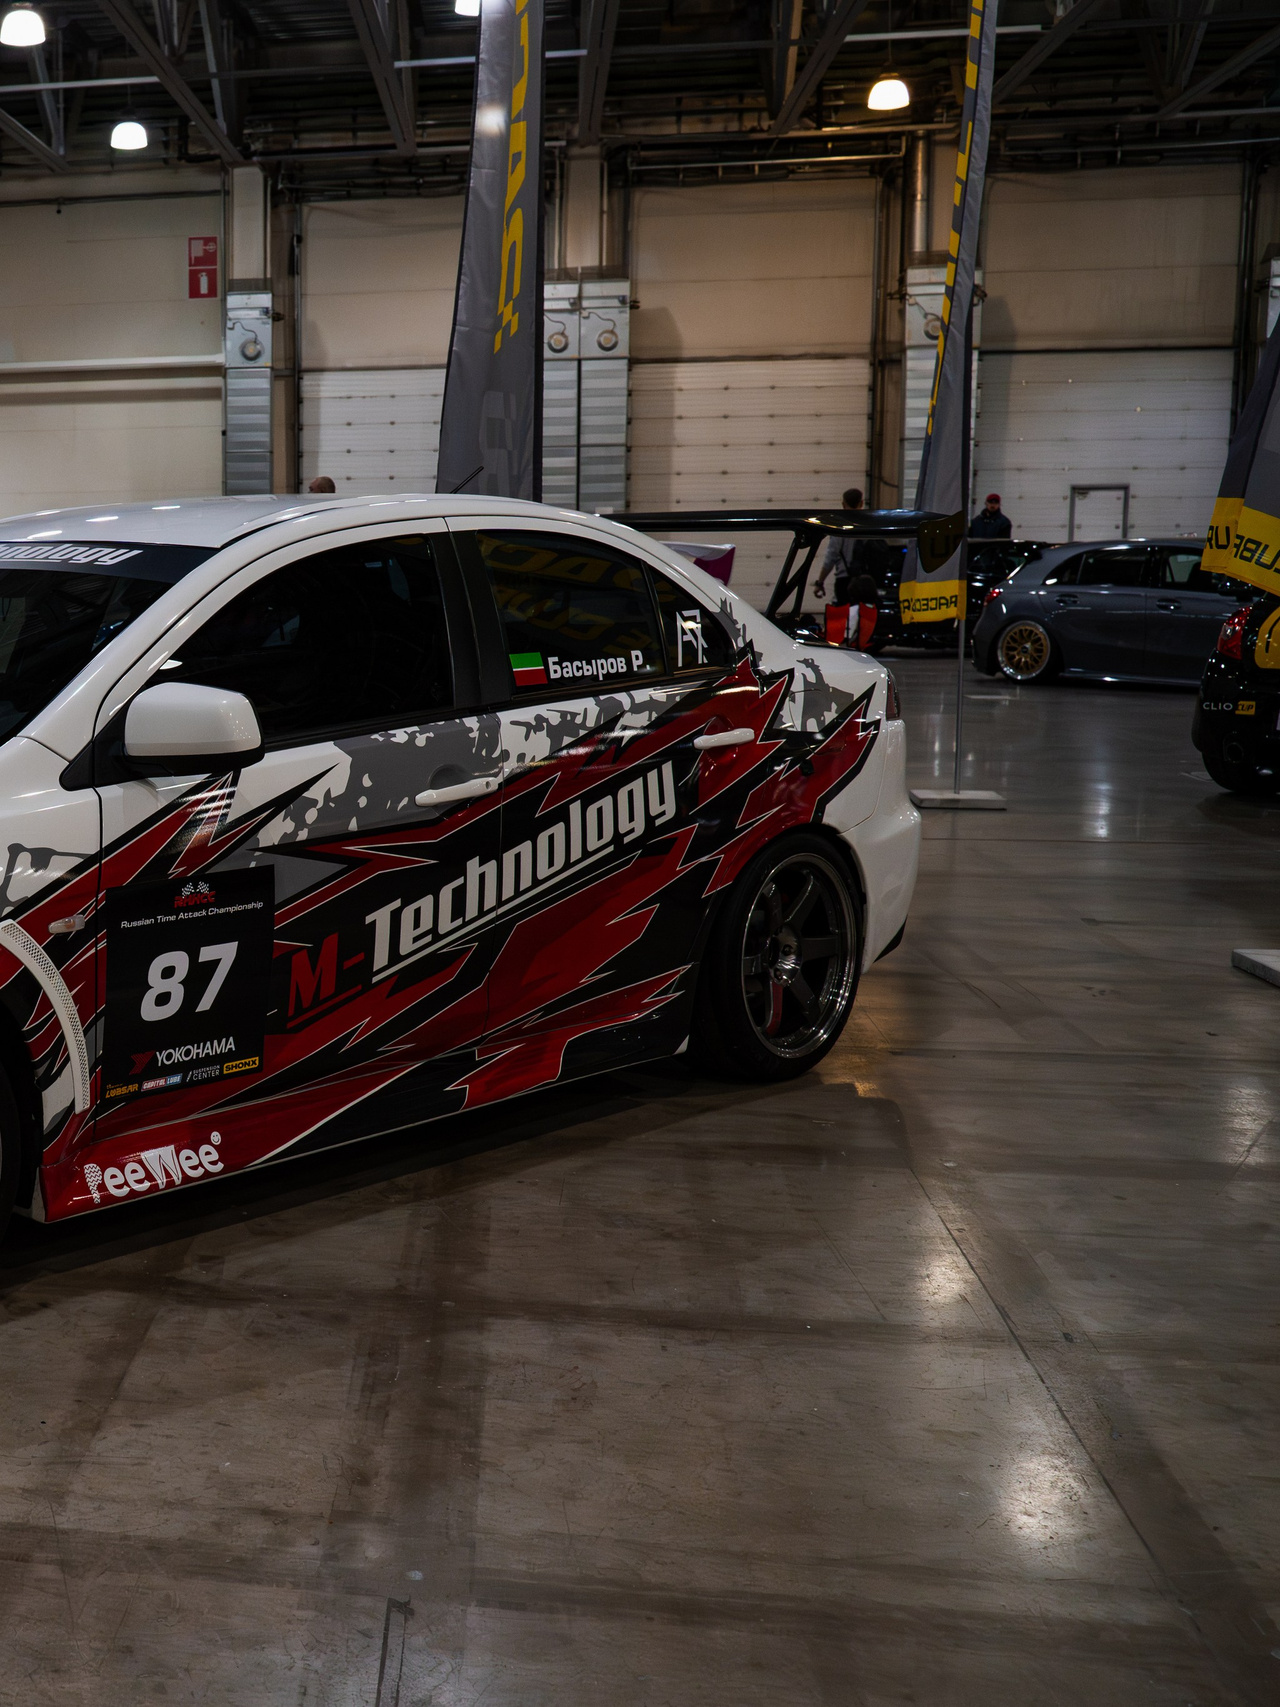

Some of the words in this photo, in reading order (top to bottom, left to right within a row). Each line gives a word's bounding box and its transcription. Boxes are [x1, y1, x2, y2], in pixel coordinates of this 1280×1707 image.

[547, 656, 627, 681] Басыров
[1202, 702, 1233, 711] CLIO
[120, 917, 154, 929] Russian
[156, 913, 176, 924] Time
[177, 909, 207, 920] Attack
[208, 901, 264, 915] Championship
[140, 940, 239, 1022] 87
[156, 1036, 236, 1067] YOKOHAMA
[192, 1069, 220, 1081] CENTER
[225, 1058, 258, 1072] SHONX
